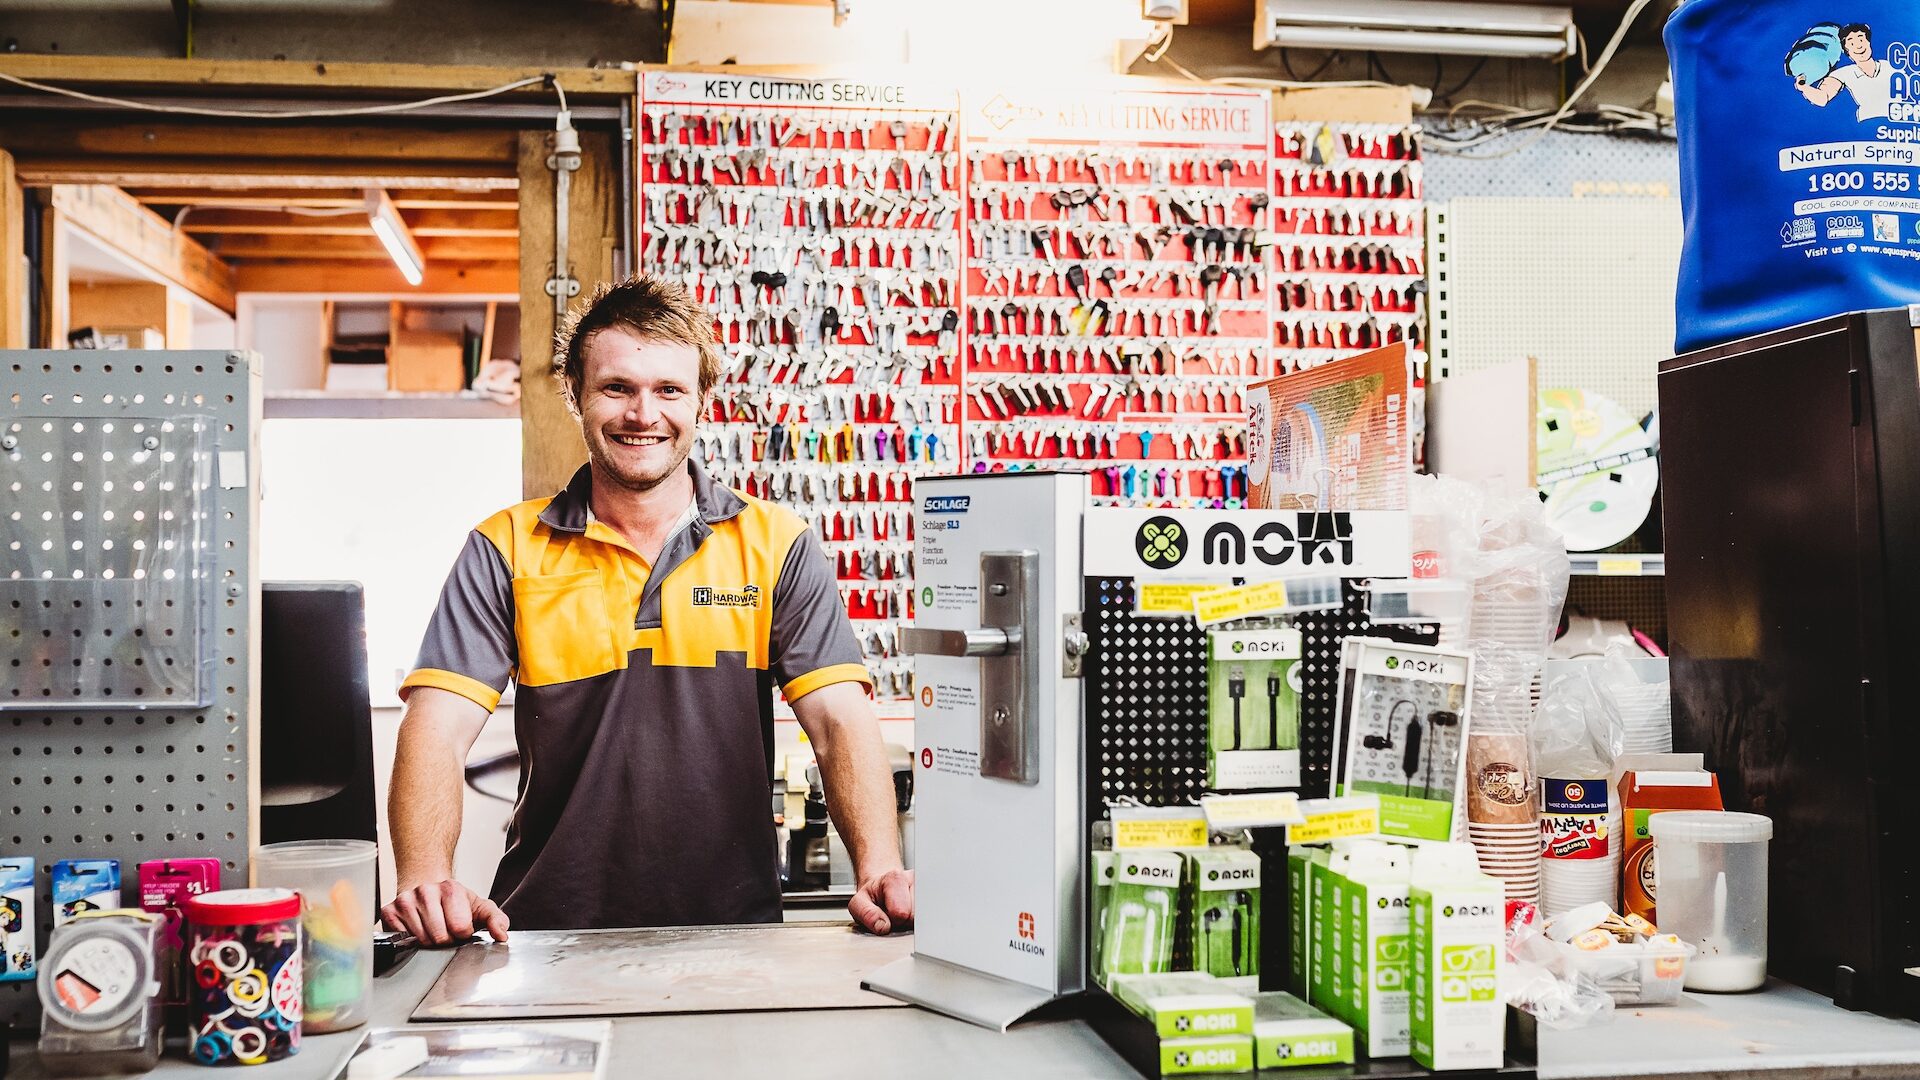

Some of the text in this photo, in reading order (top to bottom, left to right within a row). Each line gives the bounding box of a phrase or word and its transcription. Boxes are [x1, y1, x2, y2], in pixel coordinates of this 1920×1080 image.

[705, 80, 905, 103] KEY CUTTING SERVICE
[1181, 107, 1251, 132] SERVICE
[1790, 145, 1913, 164] Natural Spring
[1808, 171, 1910, 192] 1800 555
[1801, 202, 1825, 211] COOL
[1877, 200, 1920, 210] COMPANIE
[1827, 216, 1863, 228] COOL
[1805, 247, 1828, 258] Visit
[924, 498, 968, 511] SCHLAGE
[923, 520, 960, 531] Schlage SL3
[923, 536, 936, 544] Triple
[923, 546, 943, 554] Function
[923, 557, 935, 565] Entry
[713, 593, 757, 603] HARDWAE
[1568, 788, 1580, 796] 50
[1555, 841, 1586, 855] EveryDay
[1009, 940, 1045, 957] ALLEGION
